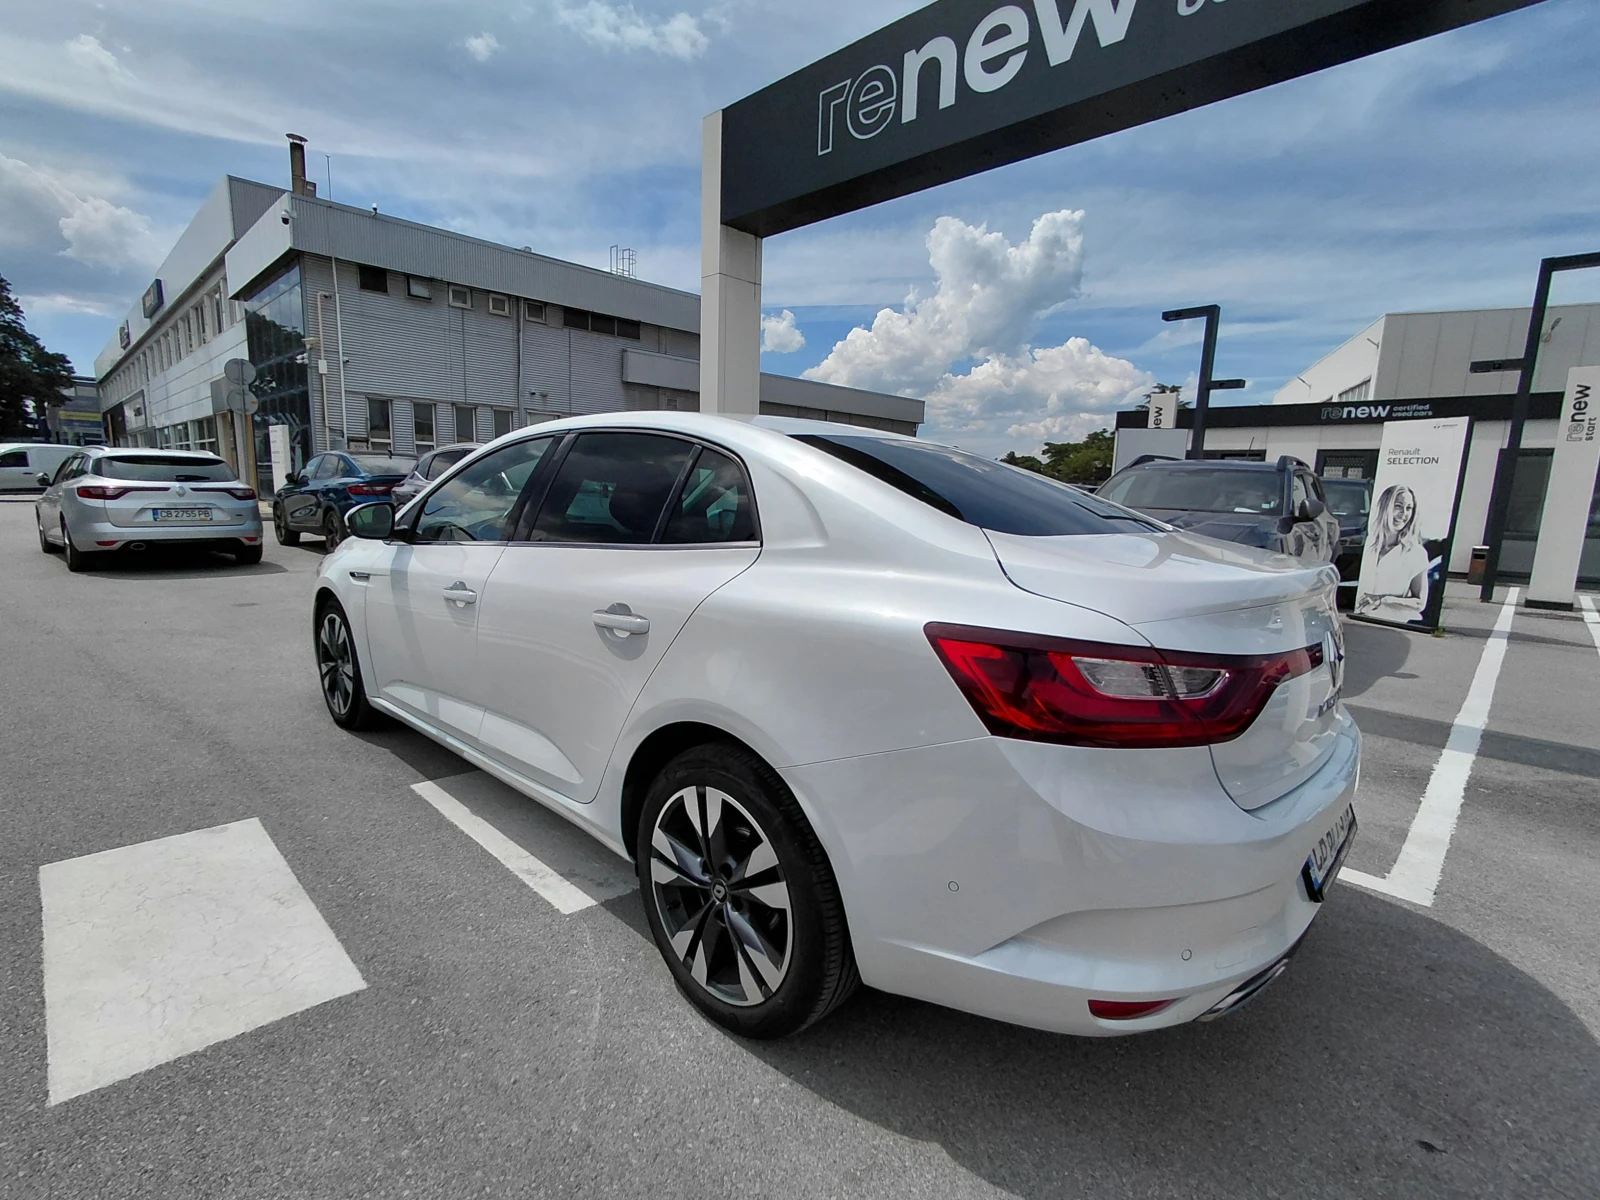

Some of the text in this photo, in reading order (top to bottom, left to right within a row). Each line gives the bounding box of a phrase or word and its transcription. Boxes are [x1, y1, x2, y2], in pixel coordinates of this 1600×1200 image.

[817, 0, 1137, 156] renew
[1321, 405, 1390, 419] renew
[1393, 403, 1430, 411] certified
[1566, 384, 1591, 441] renew
[1585, 417, 1597, 441] start
[1388, 448, 1420, 456] Renault
[1387, 456, 1440, 465] SELECTION
[160, 510, 173, 518] CB
[174, 510, 197, 518] 2755
